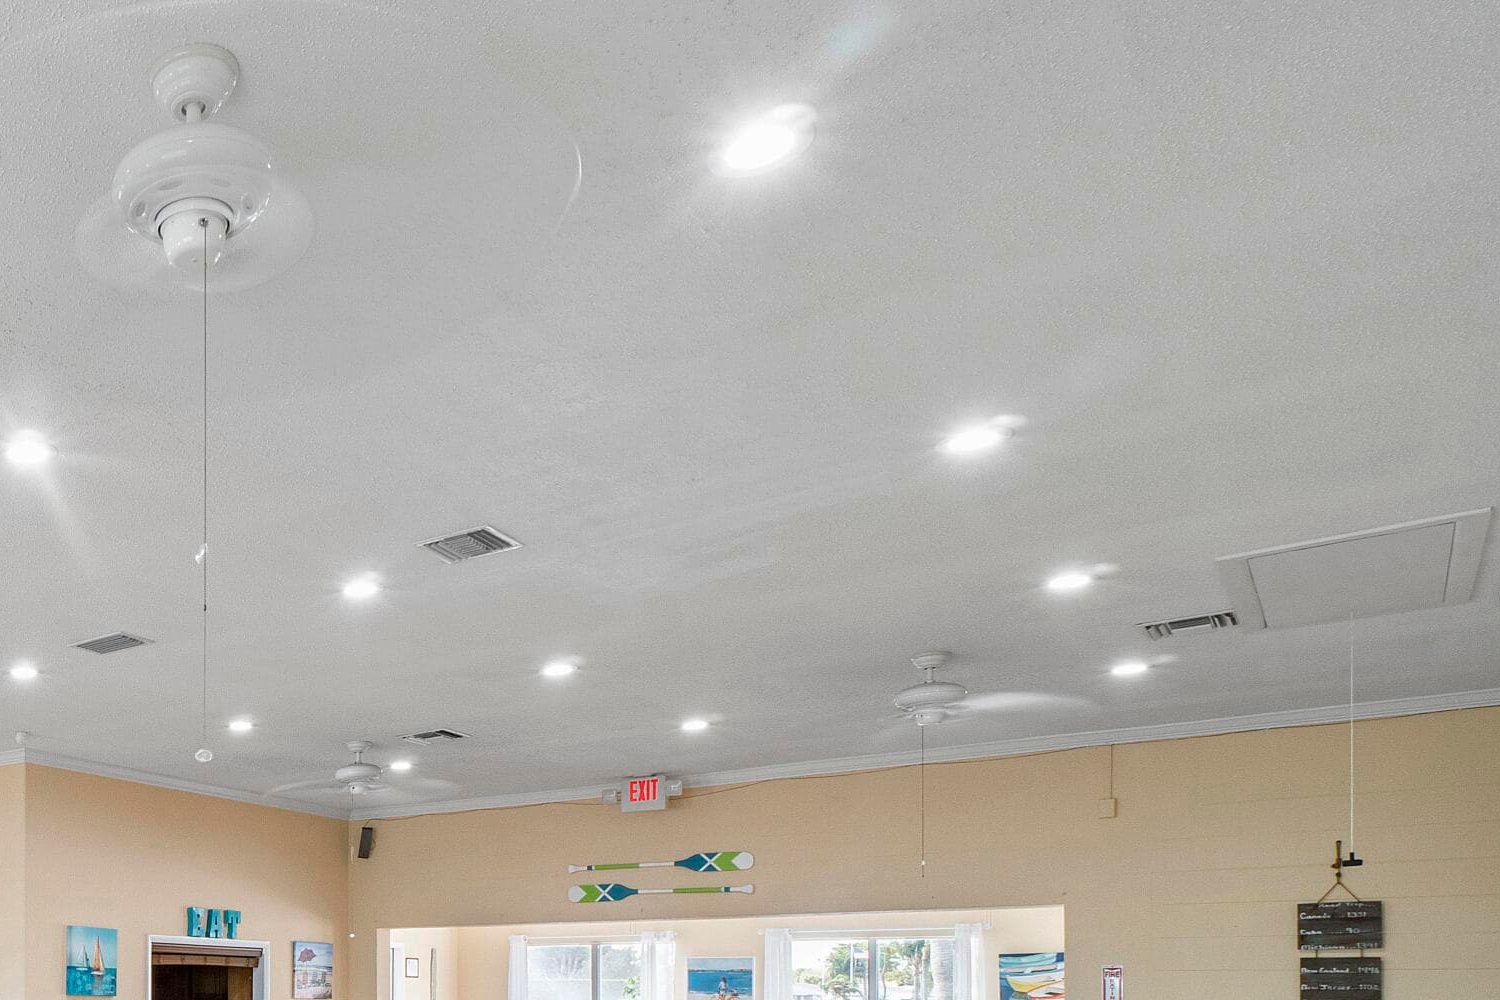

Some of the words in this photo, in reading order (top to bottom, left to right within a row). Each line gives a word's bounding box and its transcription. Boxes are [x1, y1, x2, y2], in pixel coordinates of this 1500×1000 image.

[629, 778, 659, 802] EXIT
[187, 906, 242, 939] EAT
[1300, 912, 1331, 920] Canada
